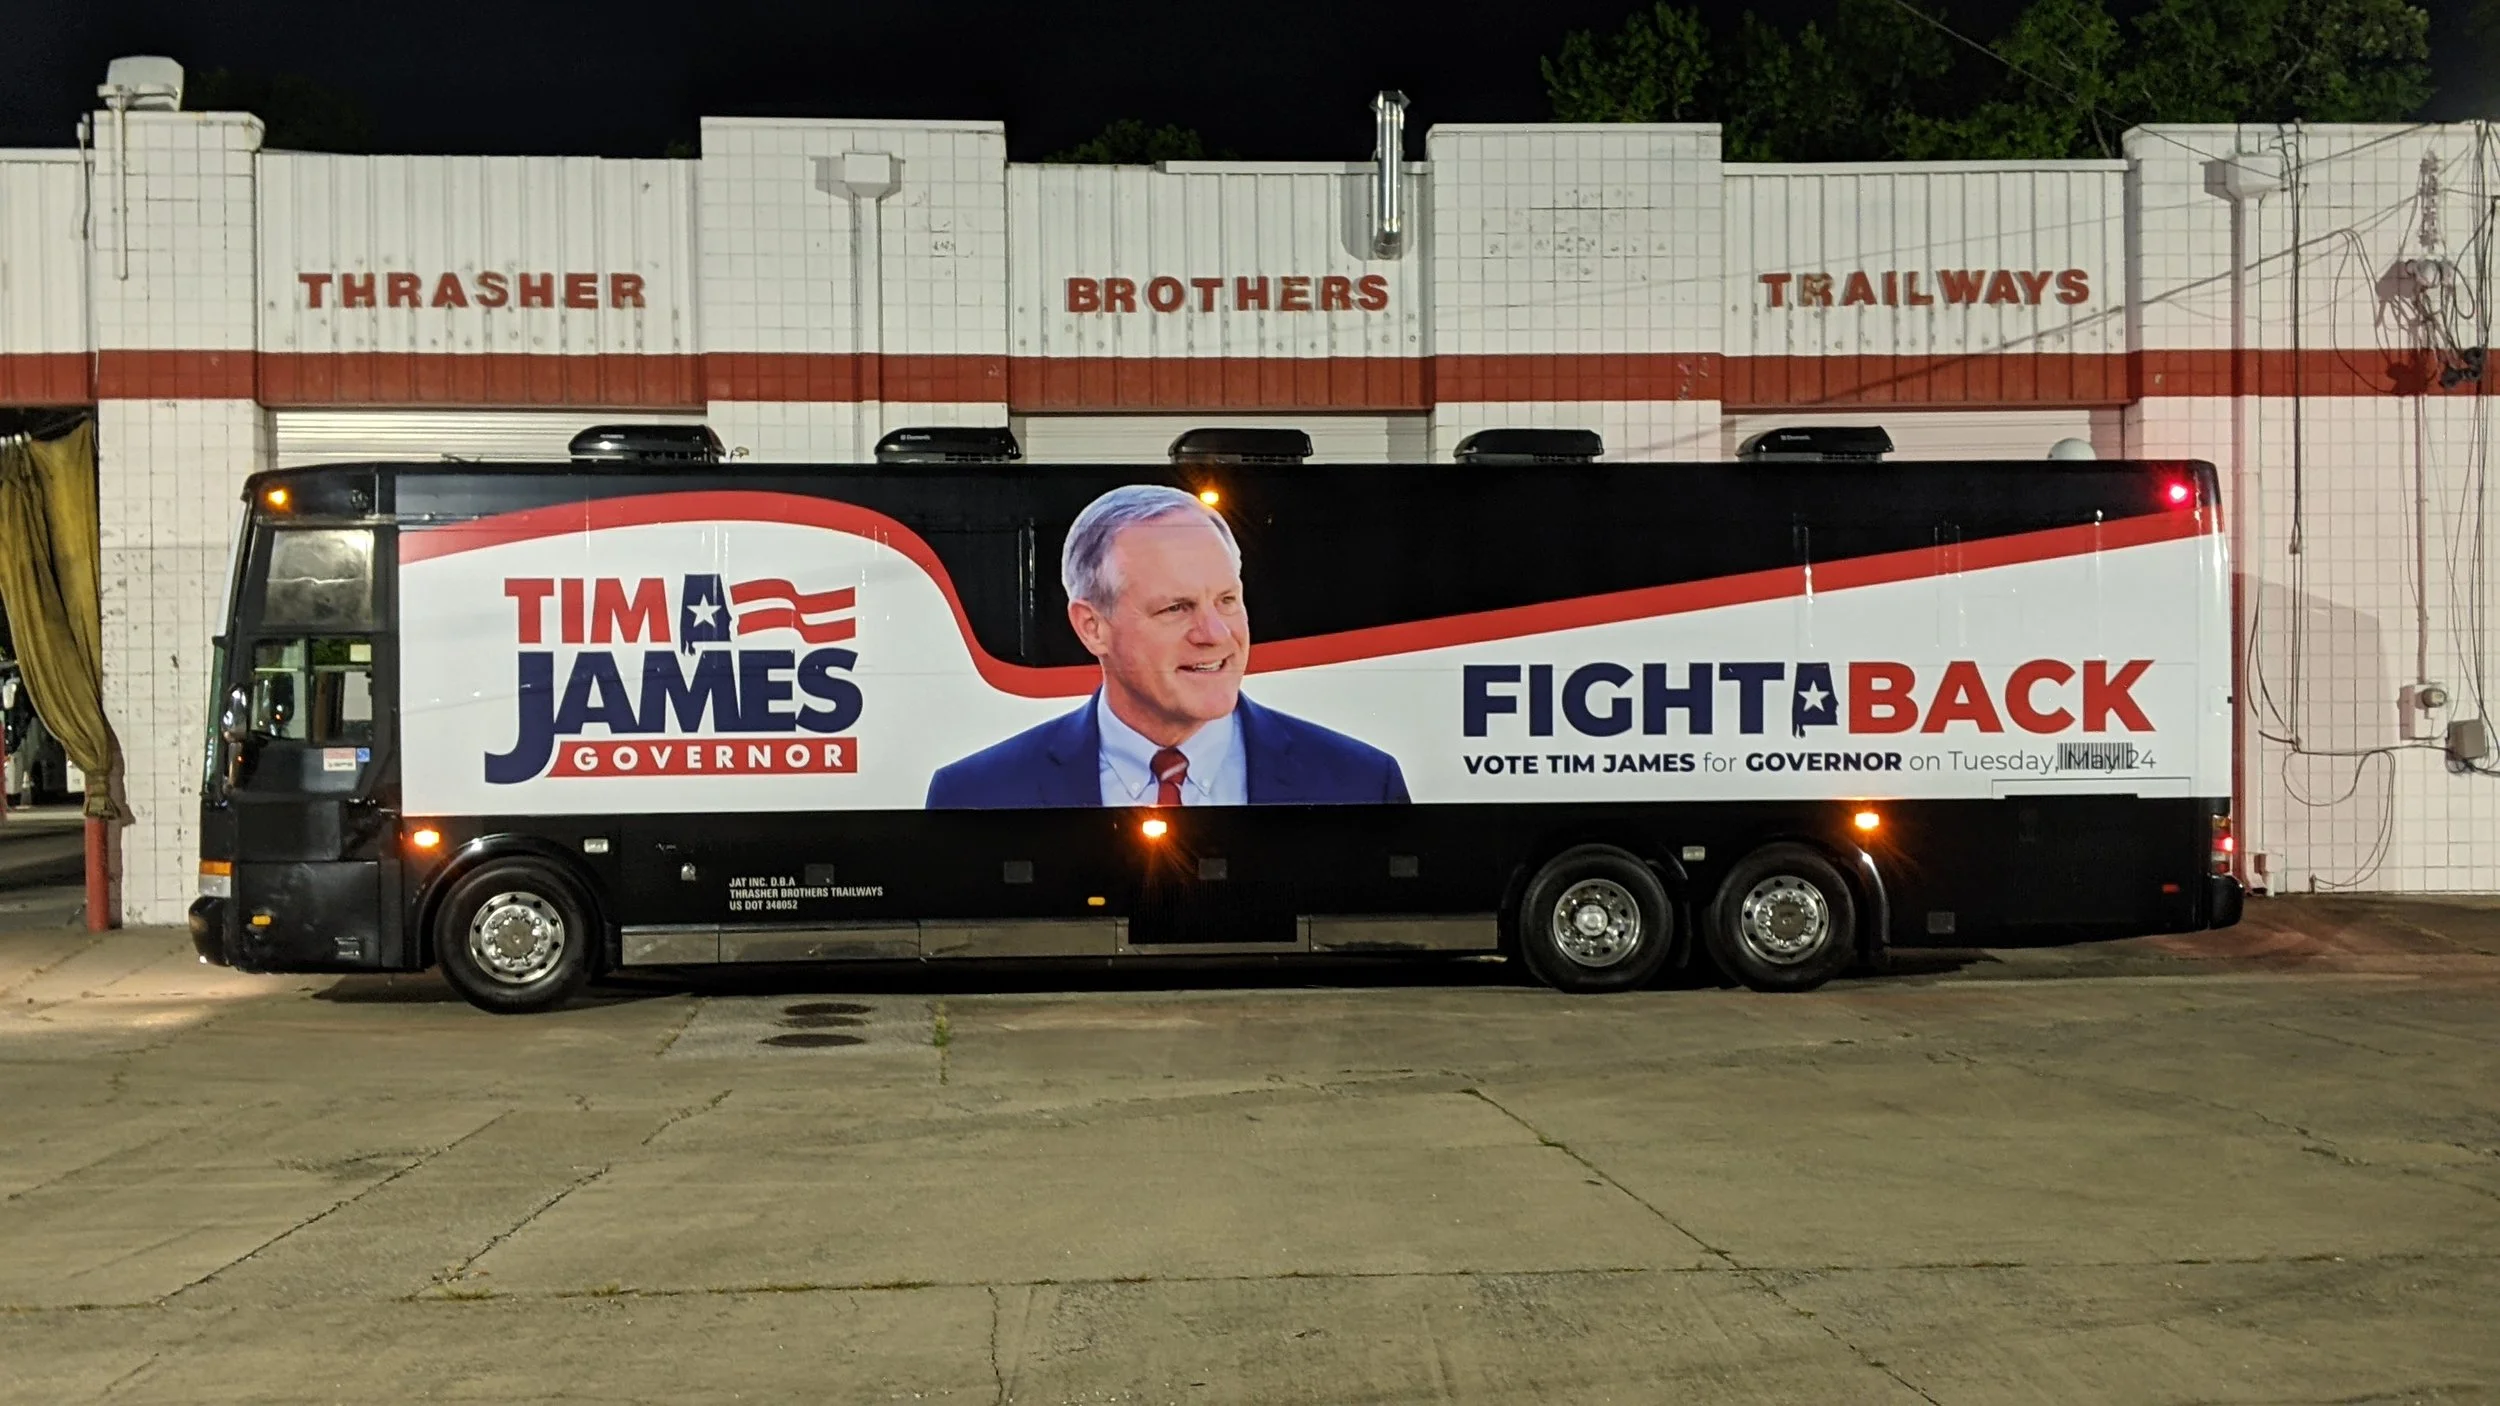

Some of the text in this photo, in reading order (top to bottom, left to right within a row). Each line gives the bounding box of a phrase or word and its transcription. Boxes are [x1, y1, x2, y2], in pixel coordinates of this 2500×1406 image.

[298, 271, 646, 308] THRASHER
[1066, 274, 1389, 313] BROTHERS
[1758, 269, 2090, 307] TRAILWAYS
[504, 577, 671, 644] TIM
[484, 647, 863, 784] JAMES
[1463, 659, 2156, 737] FIGHT BACK
[573, 743, 842, 771] GOVERNOR
[1463, 755, 1539, 775] VOTE
[1546, 754, 1595, 774] TIM
[1602, 752, 1696, 773] JAMES
[1704, 751, 1737, 773] for
[1745, 751, 1902, 772] GOVERNOR
[1909, 754, 1941, 772] on
[1948, 749, 2059, 775] Tuesday,
[2067, 750, 2120, 775] May
[729, 877, 747, 888] JAT
[749, 877, 768, 887] INC.
[730, 886, 883, 899] THRASHER BROTHERS TRAILWAYS
[729, 900, 743, 911] US
[745, 900, 763, 910] DOT
